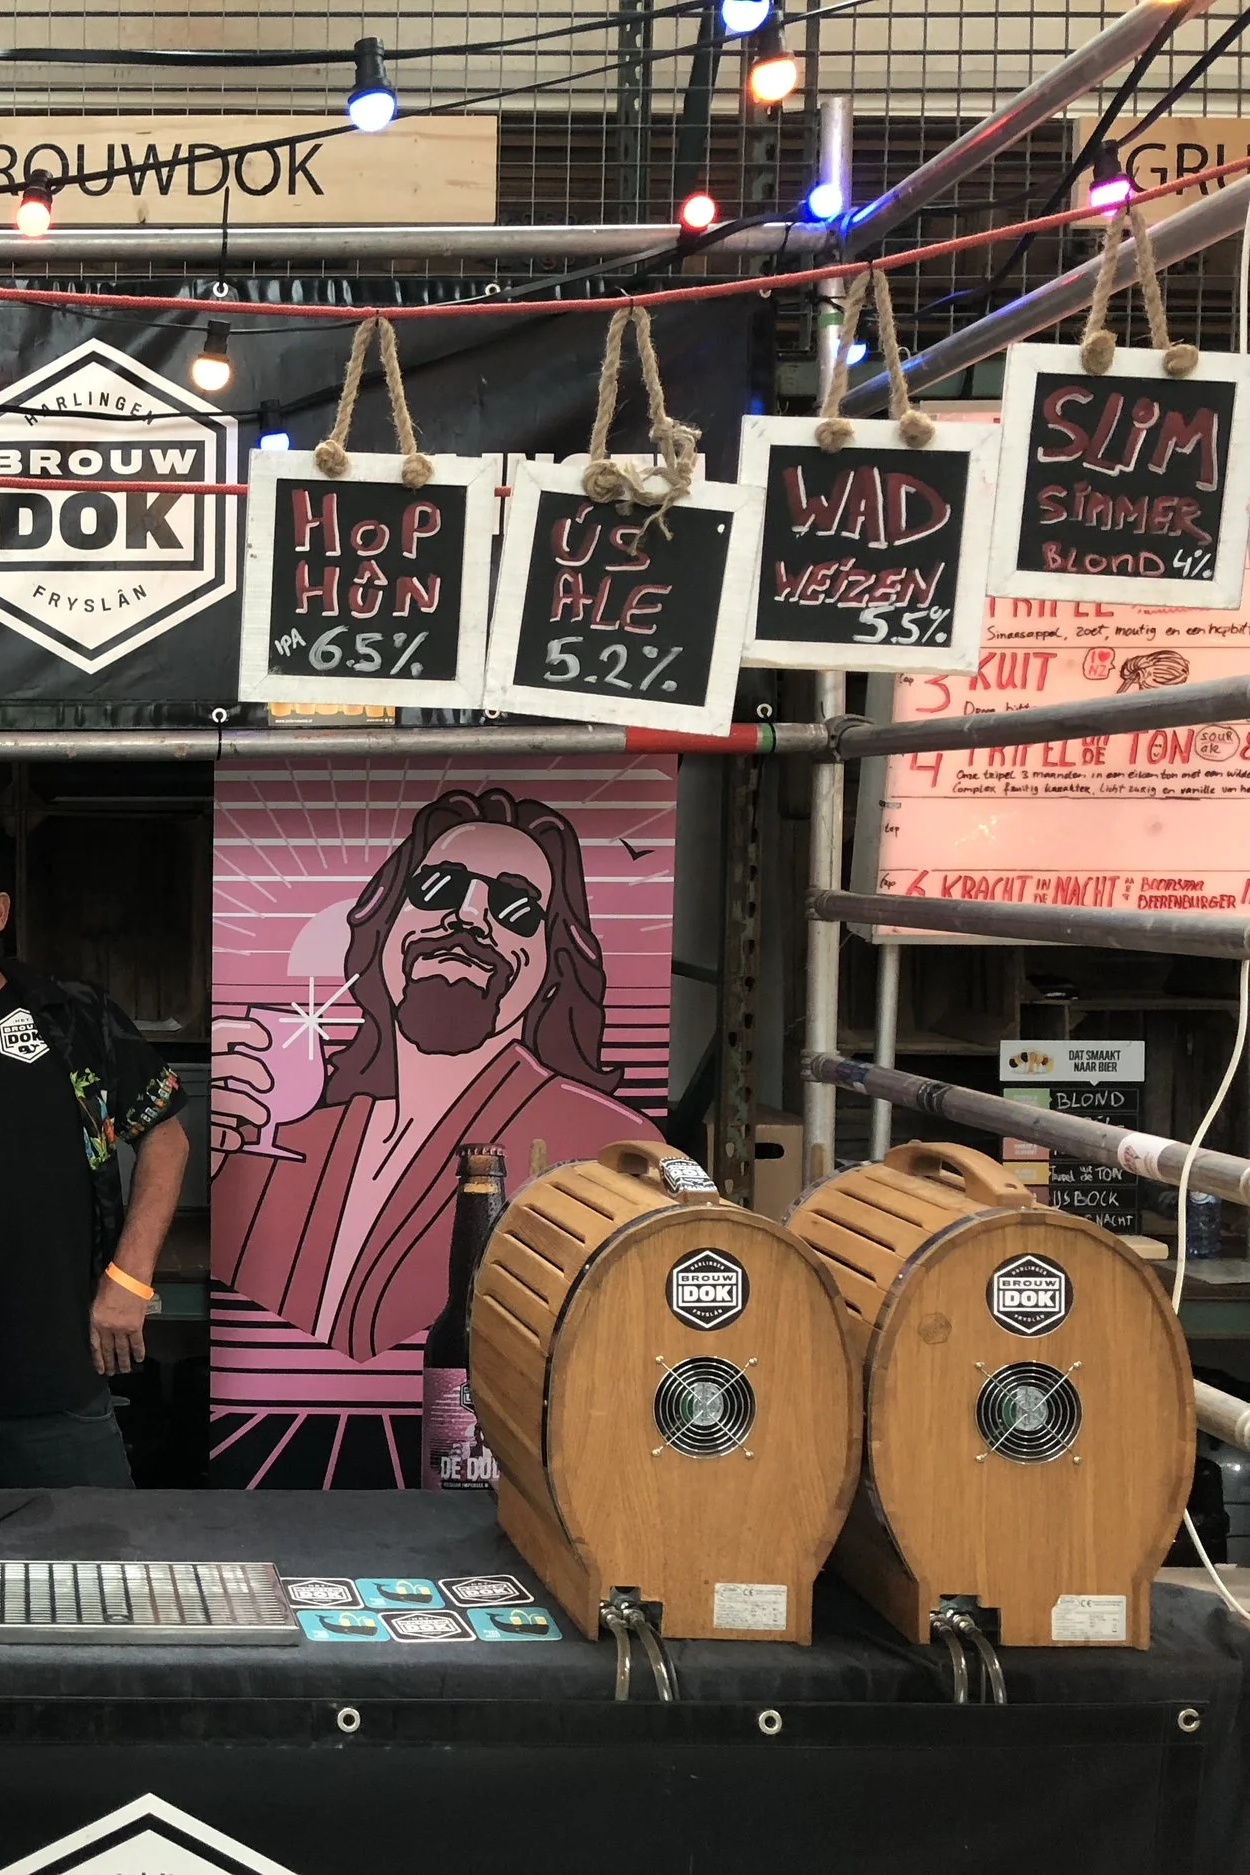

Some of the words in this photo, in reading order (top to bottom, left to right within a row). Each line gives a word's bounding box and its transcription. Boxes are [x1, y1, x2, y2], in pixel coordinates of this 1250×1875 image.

[24, 391, 156, 428] HARLINGEN
[783, 466, 951, 549] WAD
[292, 489, 441, 560] HoP
[1172, 547, 1214, 580] 4%
[32, 583, 149, 613] FRYSLÂN
[295, 559, 441, 619] HÛN
[551, 567, 673, 634] ALE
[852, 605, 951, 645] 5.5%
[1165, 627, 1181, 636] en
[274, 628, 308, 658] IPA
[308, 625, 430, 678] 6.5%
[544, 636, 685, 692] 5.2%
[969, 652, 1058, 691] KUIT
[1088, 664, 1107, 677] NZ
[910, 752, 943, 788] 4
[1126, 729, 1195, 765] TON
[941, 874, 1034, 902] KRACHT
[1035, 878, 1052, 891] IN
[1052, 875, 1121, 908] NACHT
[3, 1024, 35, 1034] BROU
[1068, 1050, 1086, 1061] DAT
[1086, 1050, 1121, 1061] SMAAKT
[1073, 1062, 1097, 1073] NAAR
[1098, 1062, 1118, 1073] BIER
[1056, 1090, 1126, 1109] BLOND
[1095, 1166, 1123, 1181] TON
[1095, 1213, 1134, 1227] NACHT
[683, 1286, 732, 1302] DOK
[1004, 1290, 1055, 1307] DOK
[440, 1456, 461, 1480] DE
